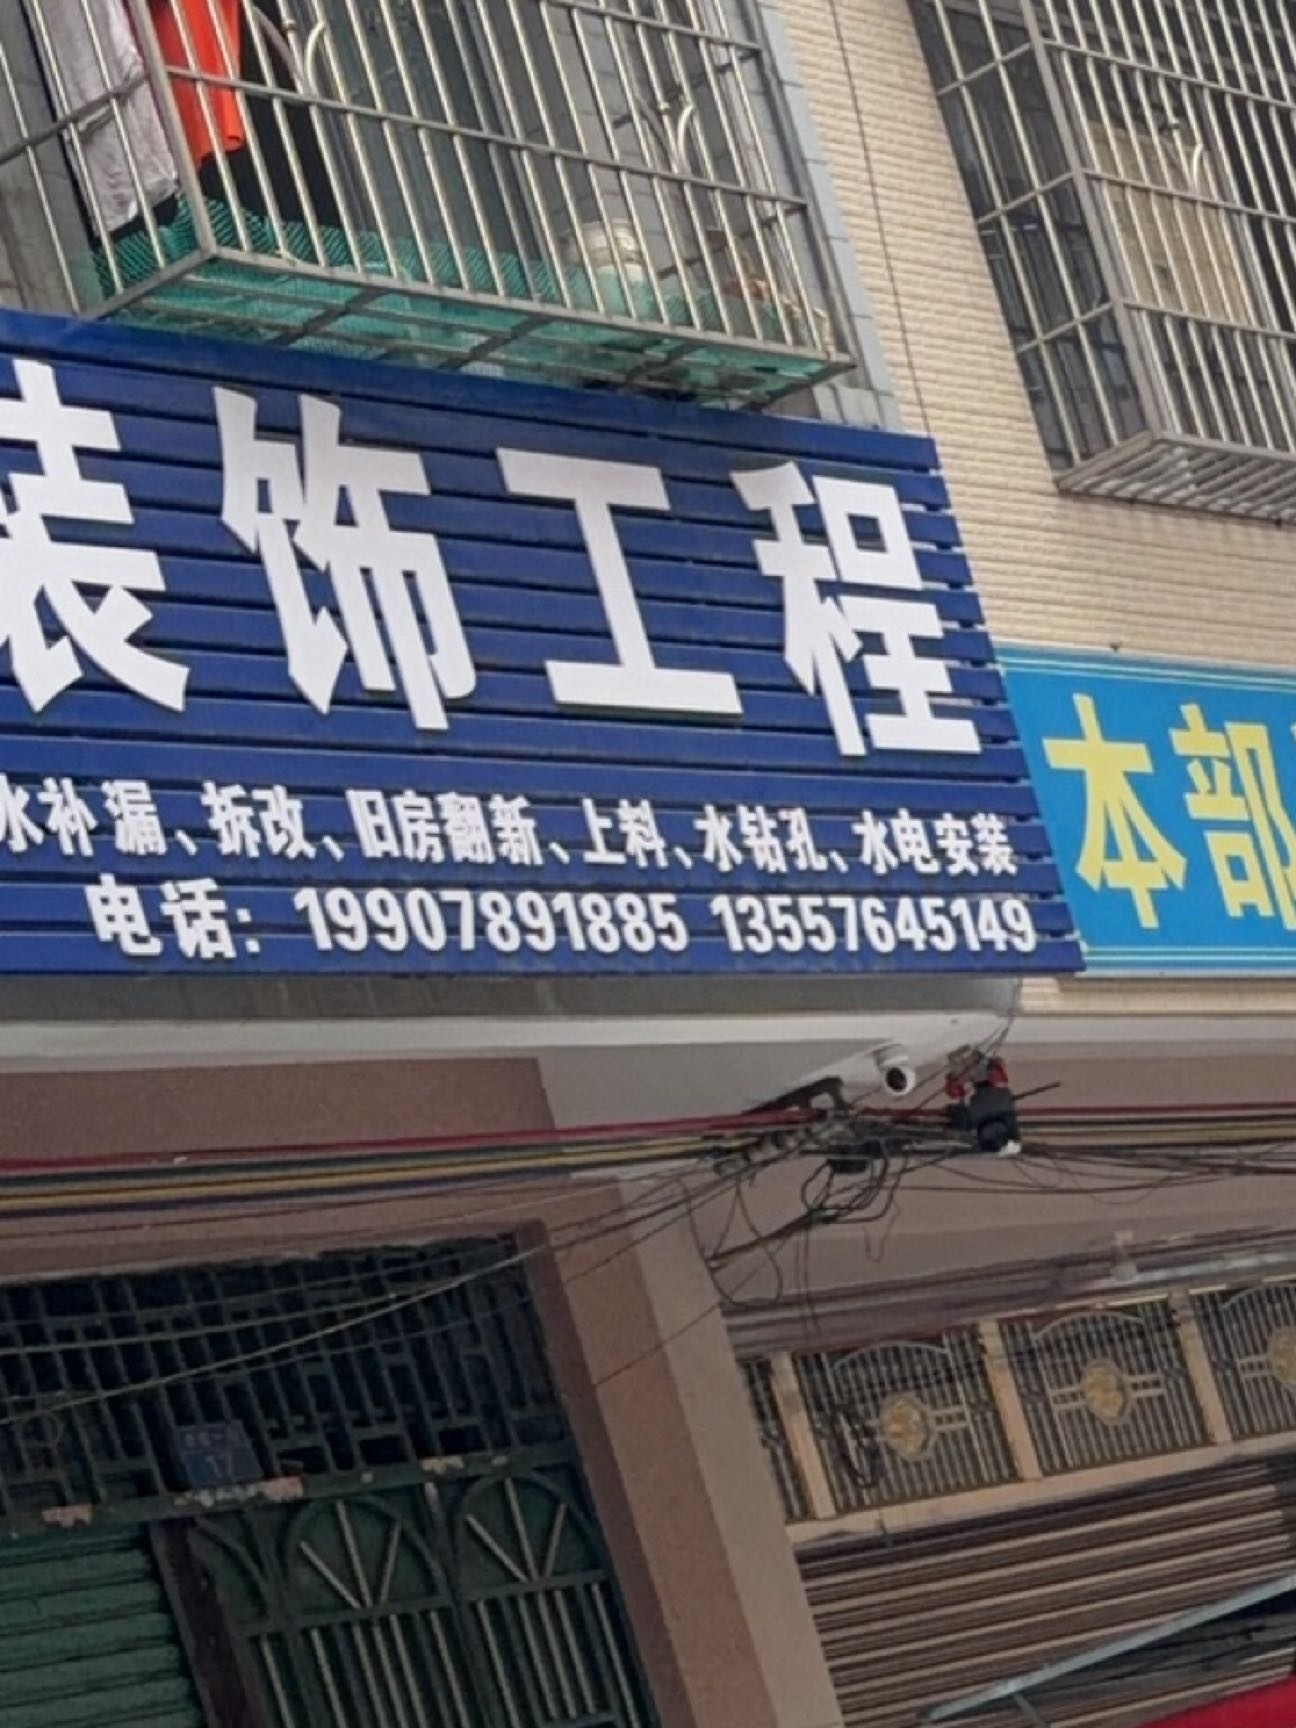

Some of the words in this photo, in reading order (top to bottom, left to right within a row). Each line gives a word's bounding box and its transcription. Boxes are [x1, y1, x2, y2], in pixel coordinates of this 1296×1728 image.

[0, 358, 982, 757] 装饰工程
[709, 893, 1037, 954] 13557645149
